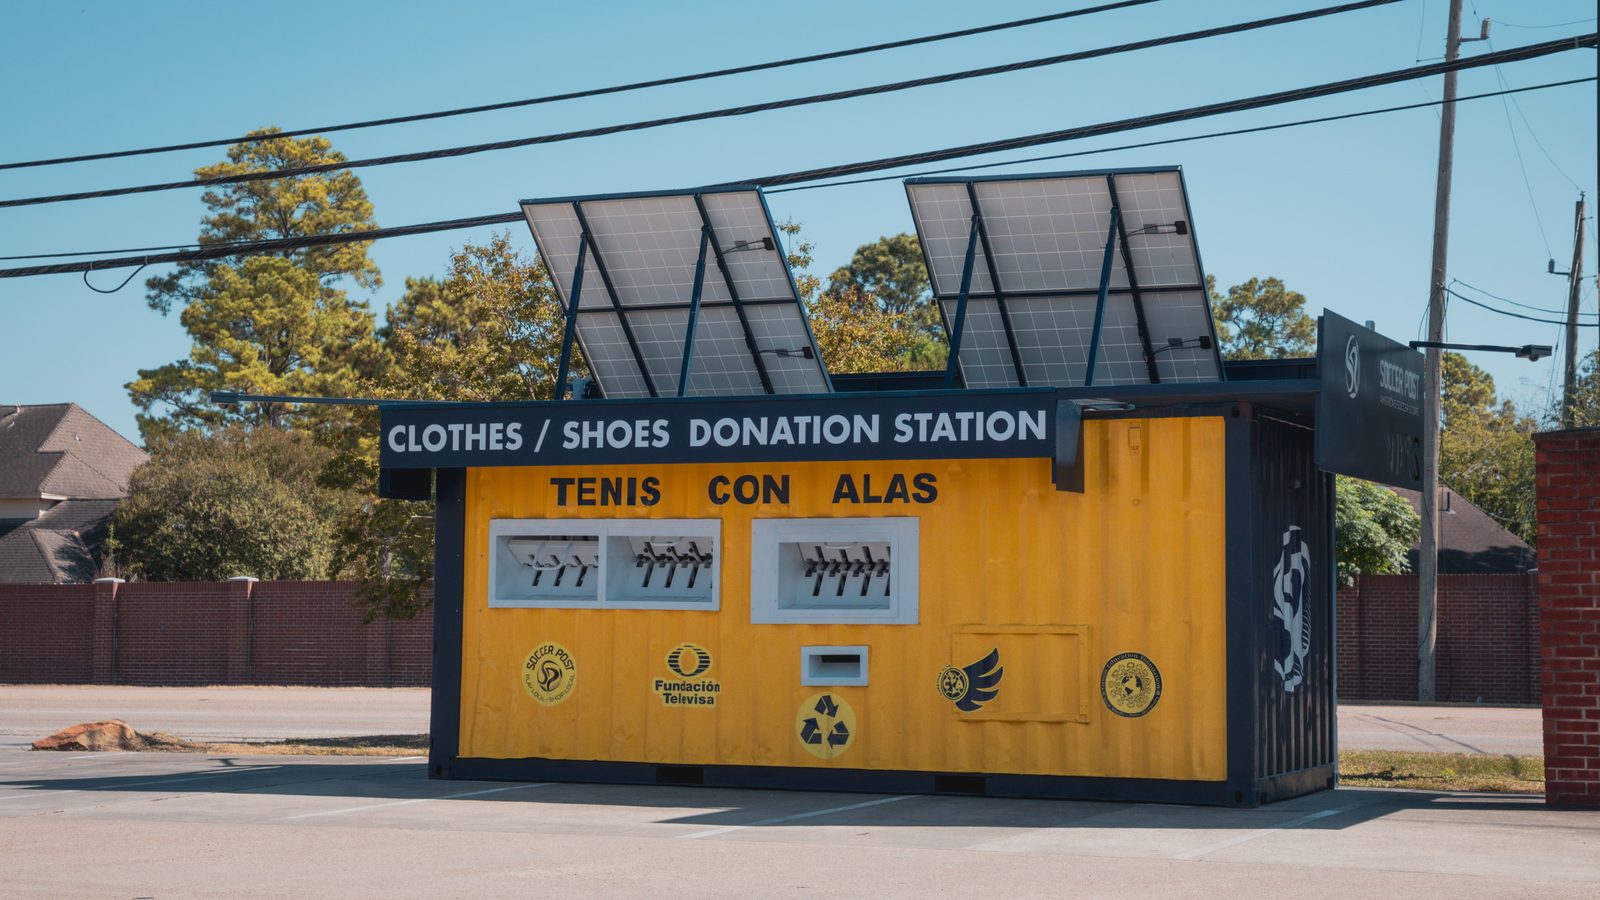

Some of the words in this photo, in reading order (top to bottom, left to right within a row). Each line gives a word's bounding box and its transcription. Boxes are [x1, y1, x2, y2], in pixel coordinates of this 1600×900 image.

[1379, 359, 1404, 396] SOCCER
[1404, 370, 1420, 401] POST
[387, 422, 523, 453] CLOTHES
[533, 419, 551, 453] /
[562, 418, 671, 450] SHOES
[689, 414, 880, 448] DONATION
[893, 410, 1047, 443] STATION
[550, 477, 661, 507] TENIS
[707, 475, 790, 506] CON
[831, 473, 939, 505] ALAS
[526, 645, 554, 671] SOCCER
[555, 648, 575, 671] POST
[655, 679, 720, 693] Fundación
[662, 692, 715, 706] Televisa
